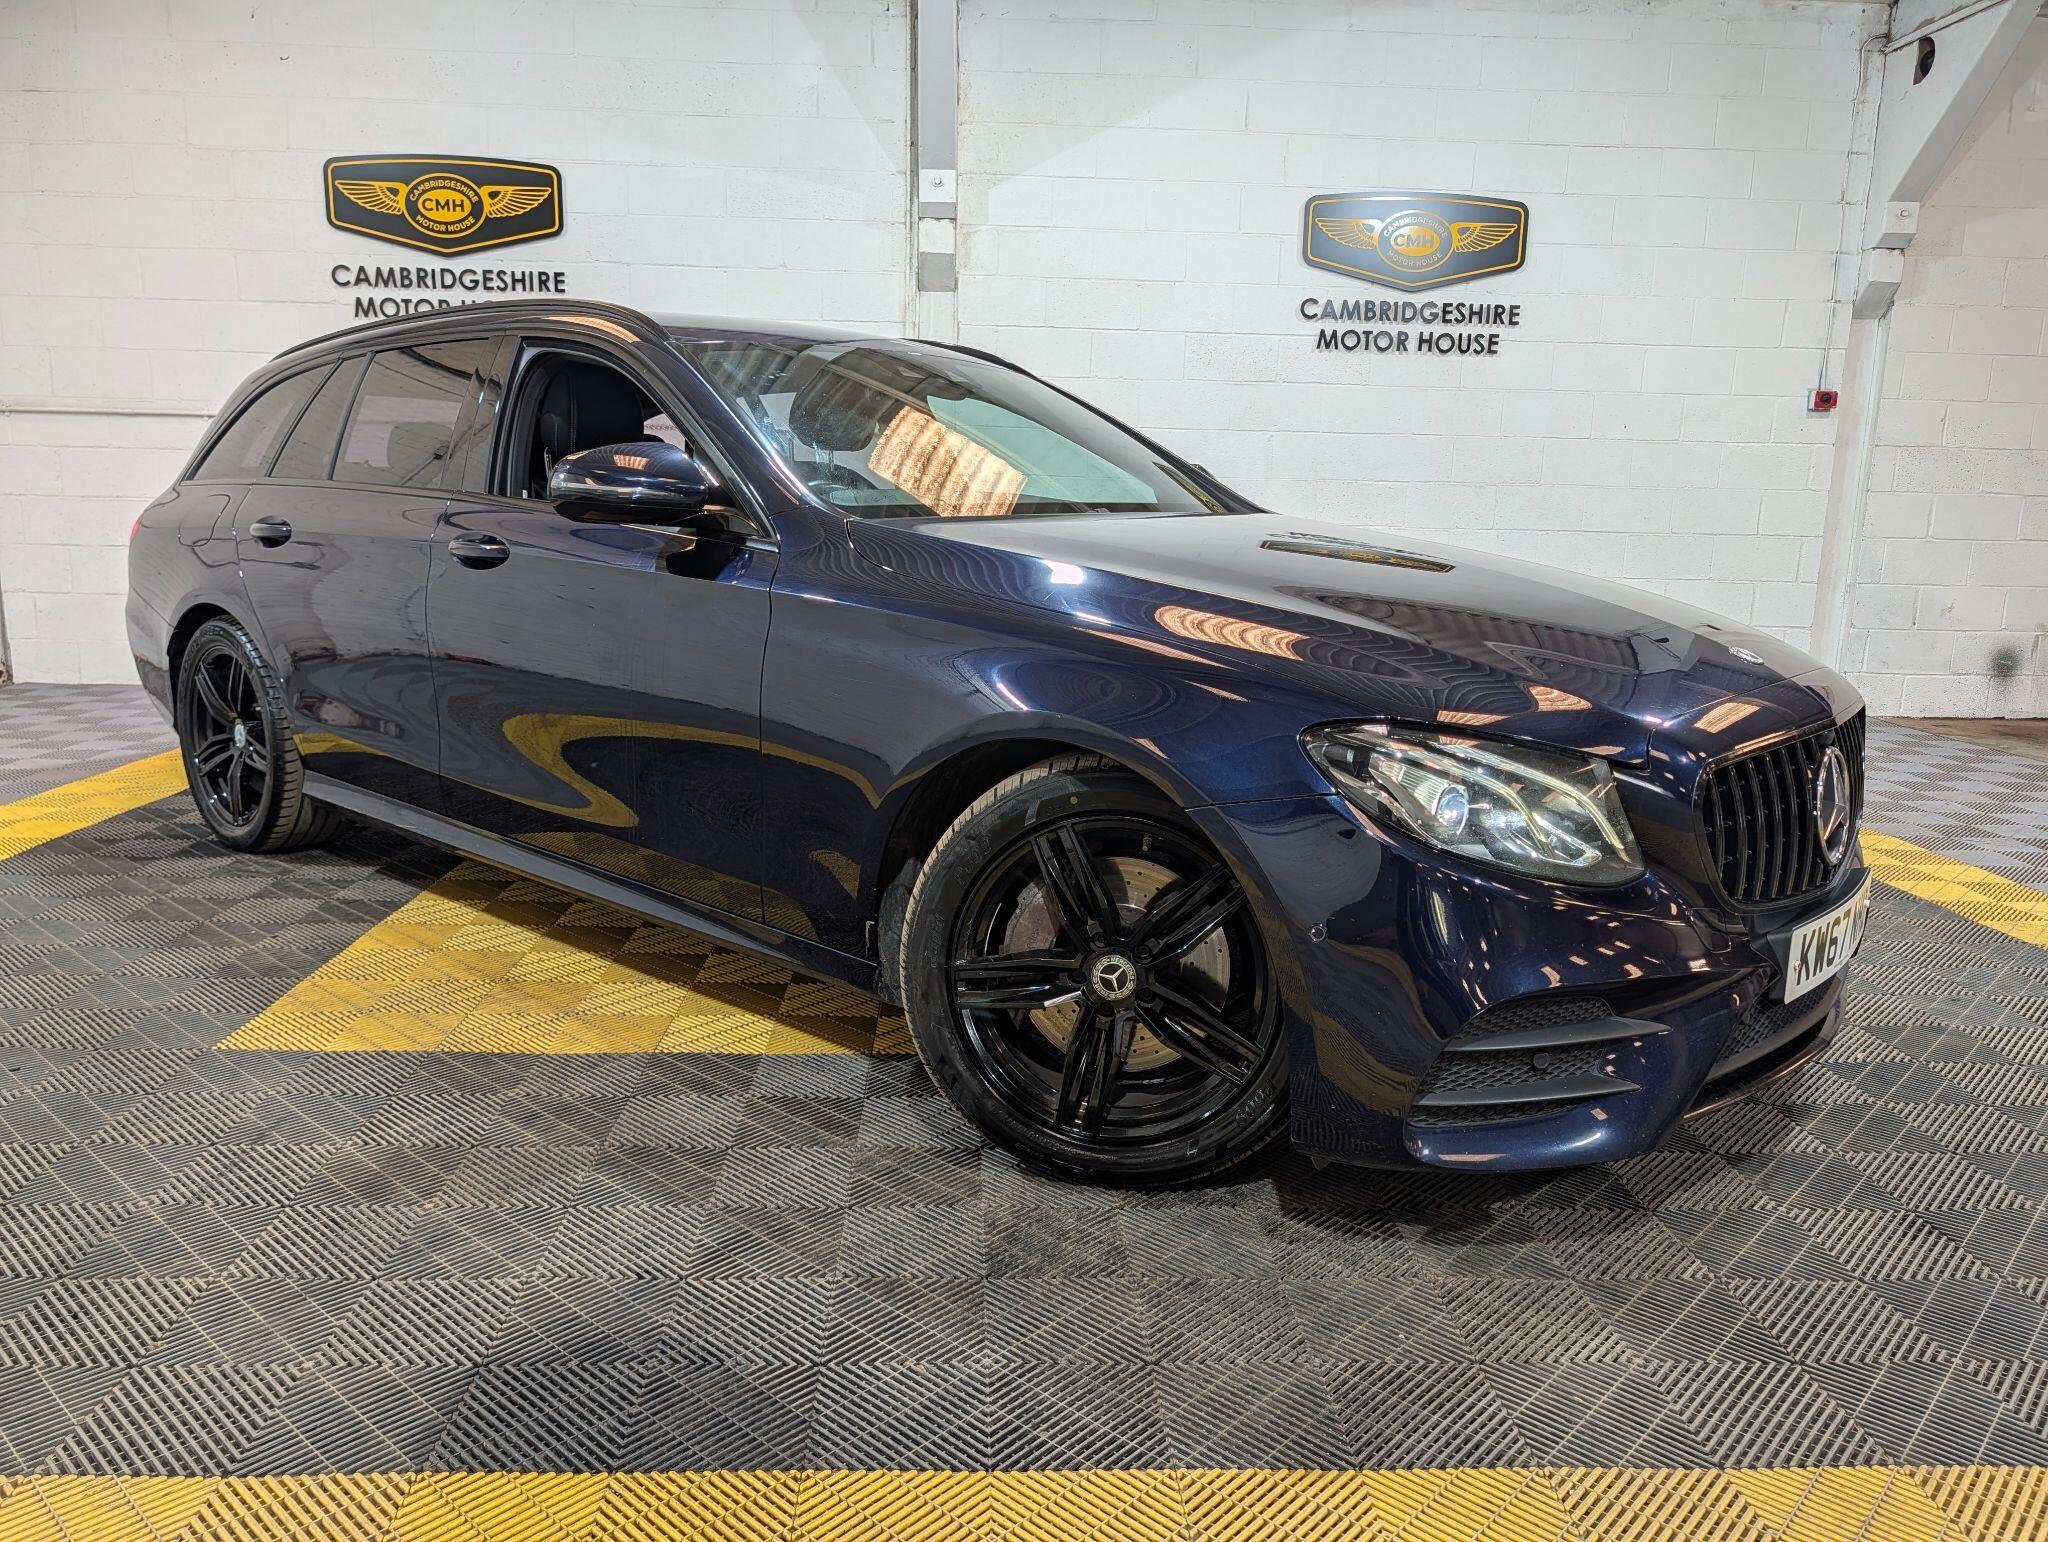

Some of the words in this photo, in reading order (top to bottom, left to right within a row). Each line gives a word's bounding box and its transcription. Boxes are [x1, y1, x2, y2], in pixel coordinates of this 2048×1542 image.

[409, 179, 479, 203] CAMBRIDGESHIRE
[421, 198, 465, 212] CMH
[415, 215, 446, 231] MOTOR
[447, 216, 475, 232] HOUSE
[1383, 216, 1448, 238] CAMBRIDGESHIRE
[1393, 234, 1435, 248] CMH
[1387, 250, 1413, 267] MOTOR
[1416, 251, 1443, 267] HOUSE
[331, 264, 566, 294] CAMBRIDGESHIRE
[1300, 298, 1521, 326] CAMBRIDGESHIRE
[1316, 329, 1409, 353] MOTOR
[1417, 331, 1500, 355] HOUSE
